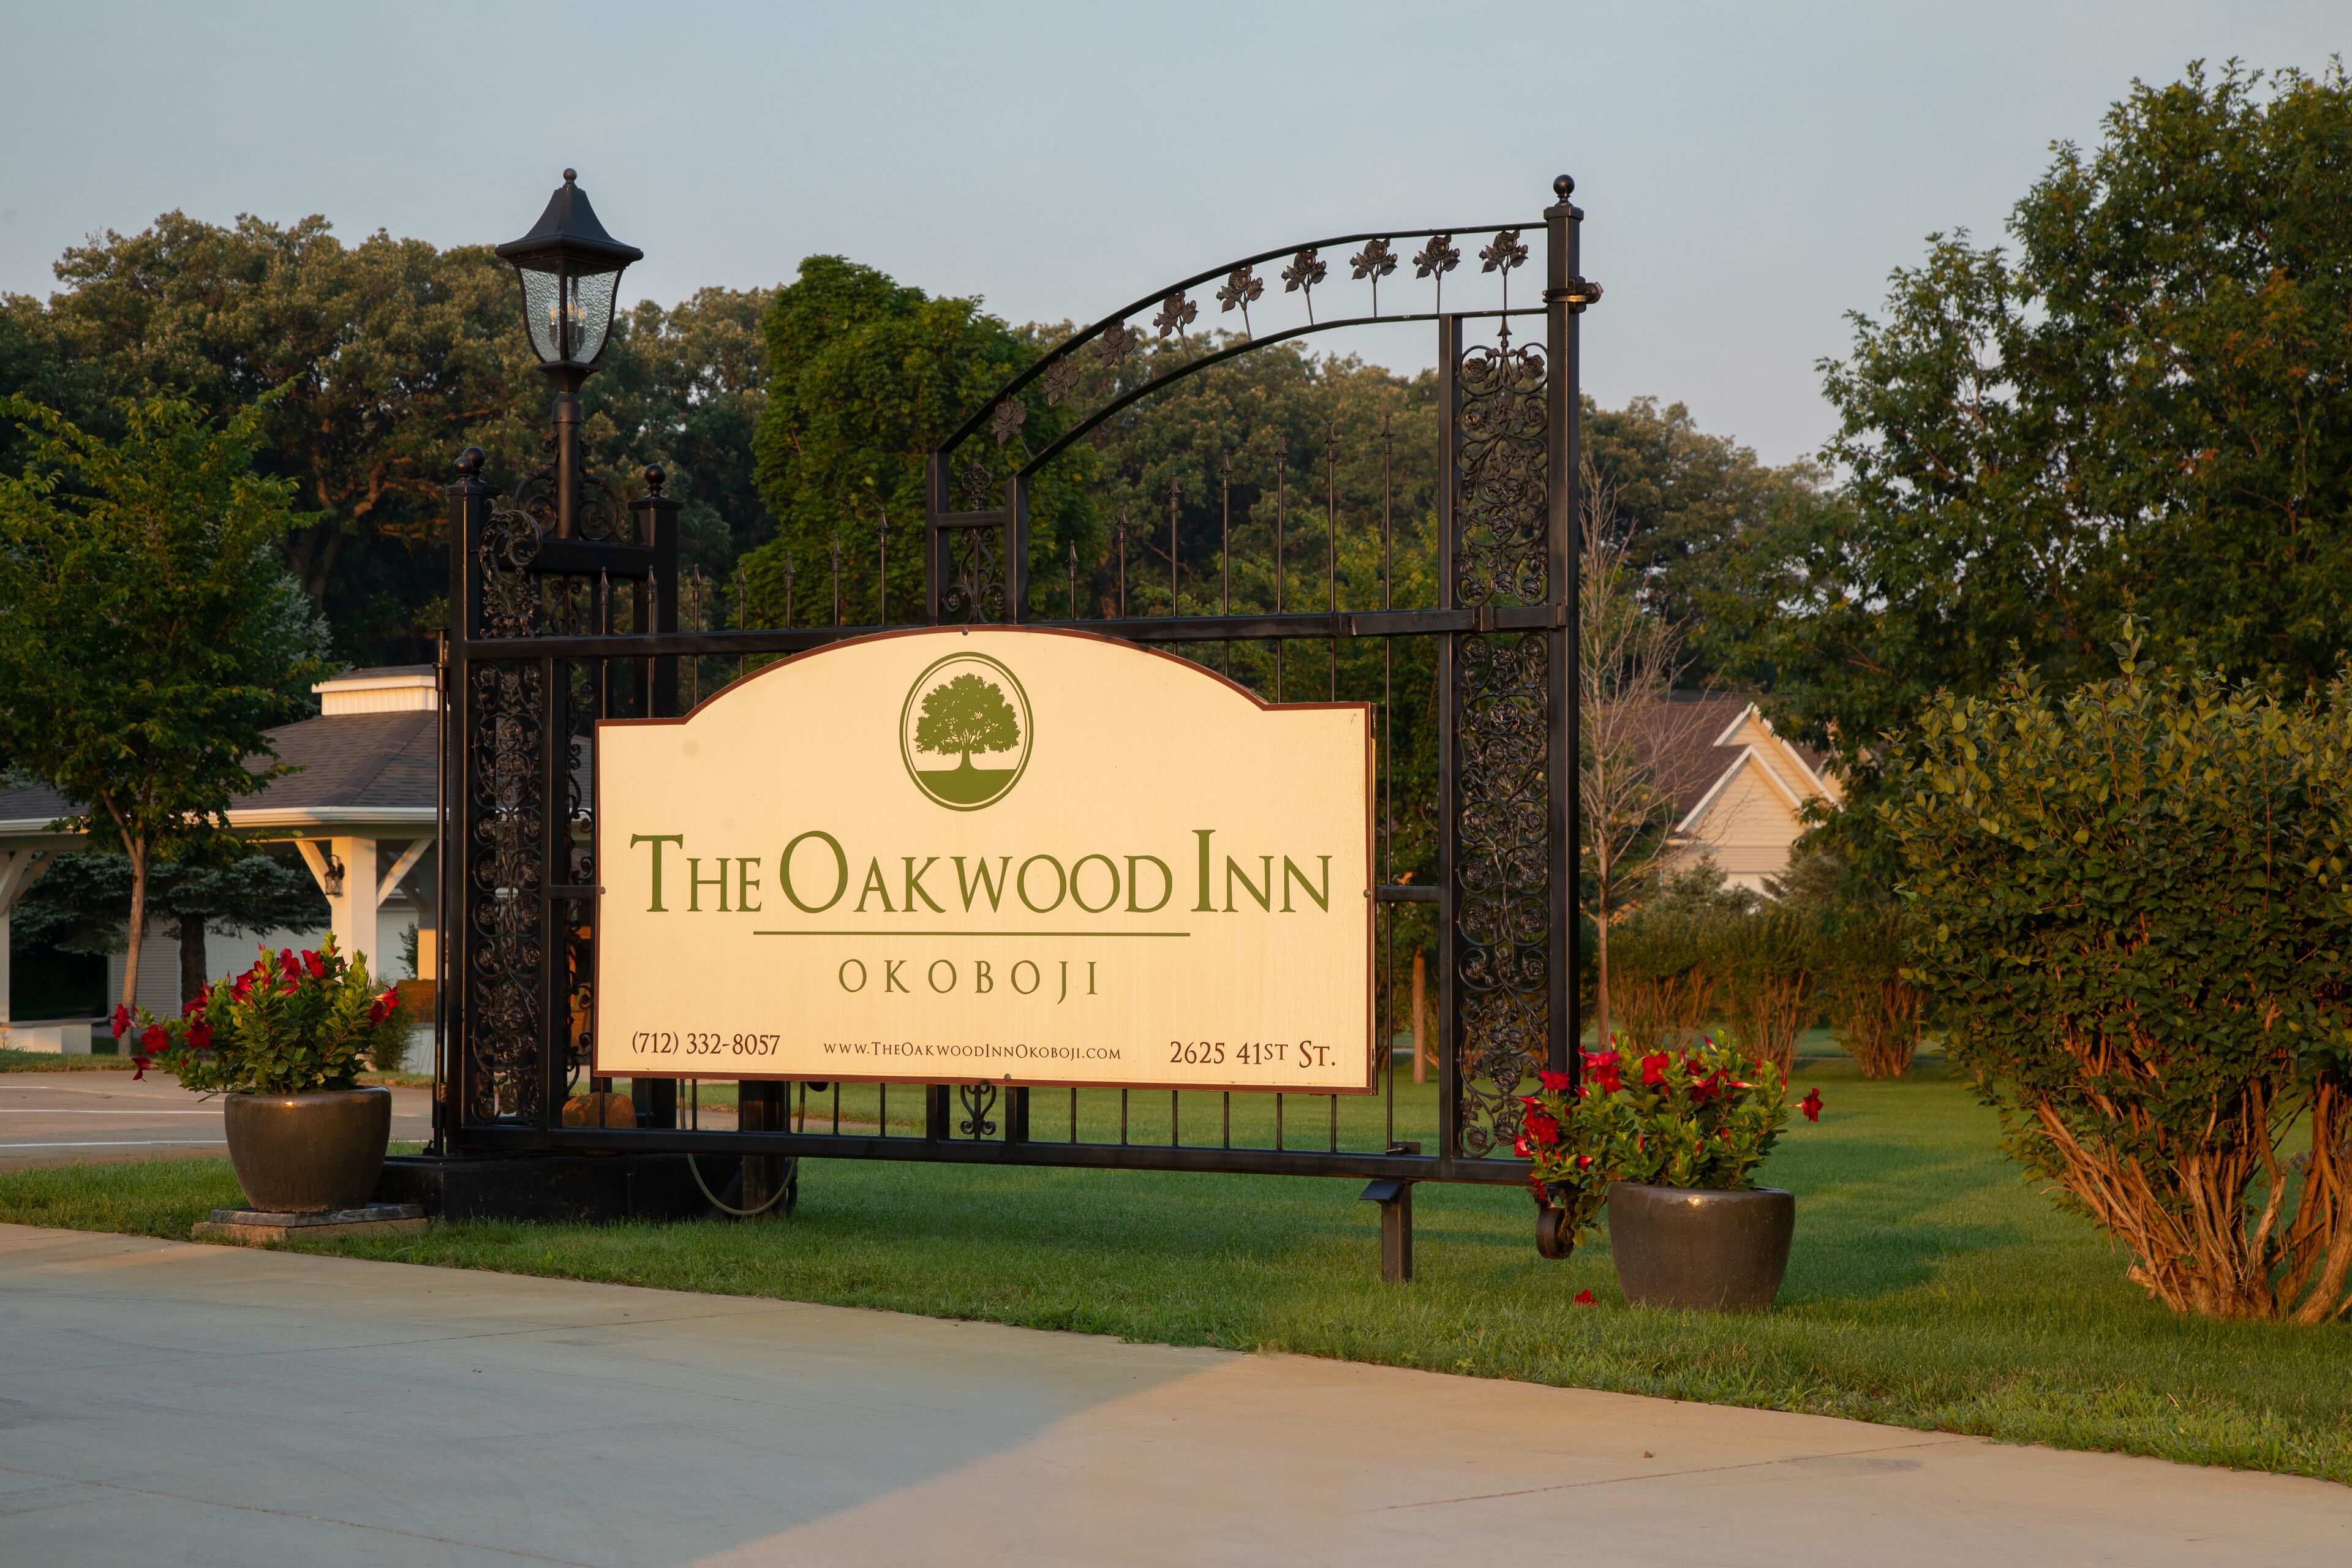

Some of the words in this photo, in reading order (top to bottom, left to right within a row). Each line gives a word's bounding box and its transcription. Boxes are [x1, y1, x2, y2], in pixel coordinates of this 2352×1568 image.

[839, 959, 1096, 1005] OKOBOJI
[631, 1031, 679, 1055] (712)
[686, 1033, 781, 1055] 332-8057
[1170, 1041, 1226, 1065] 2625
[1236, 1042, 1288, 1065] 41ST
